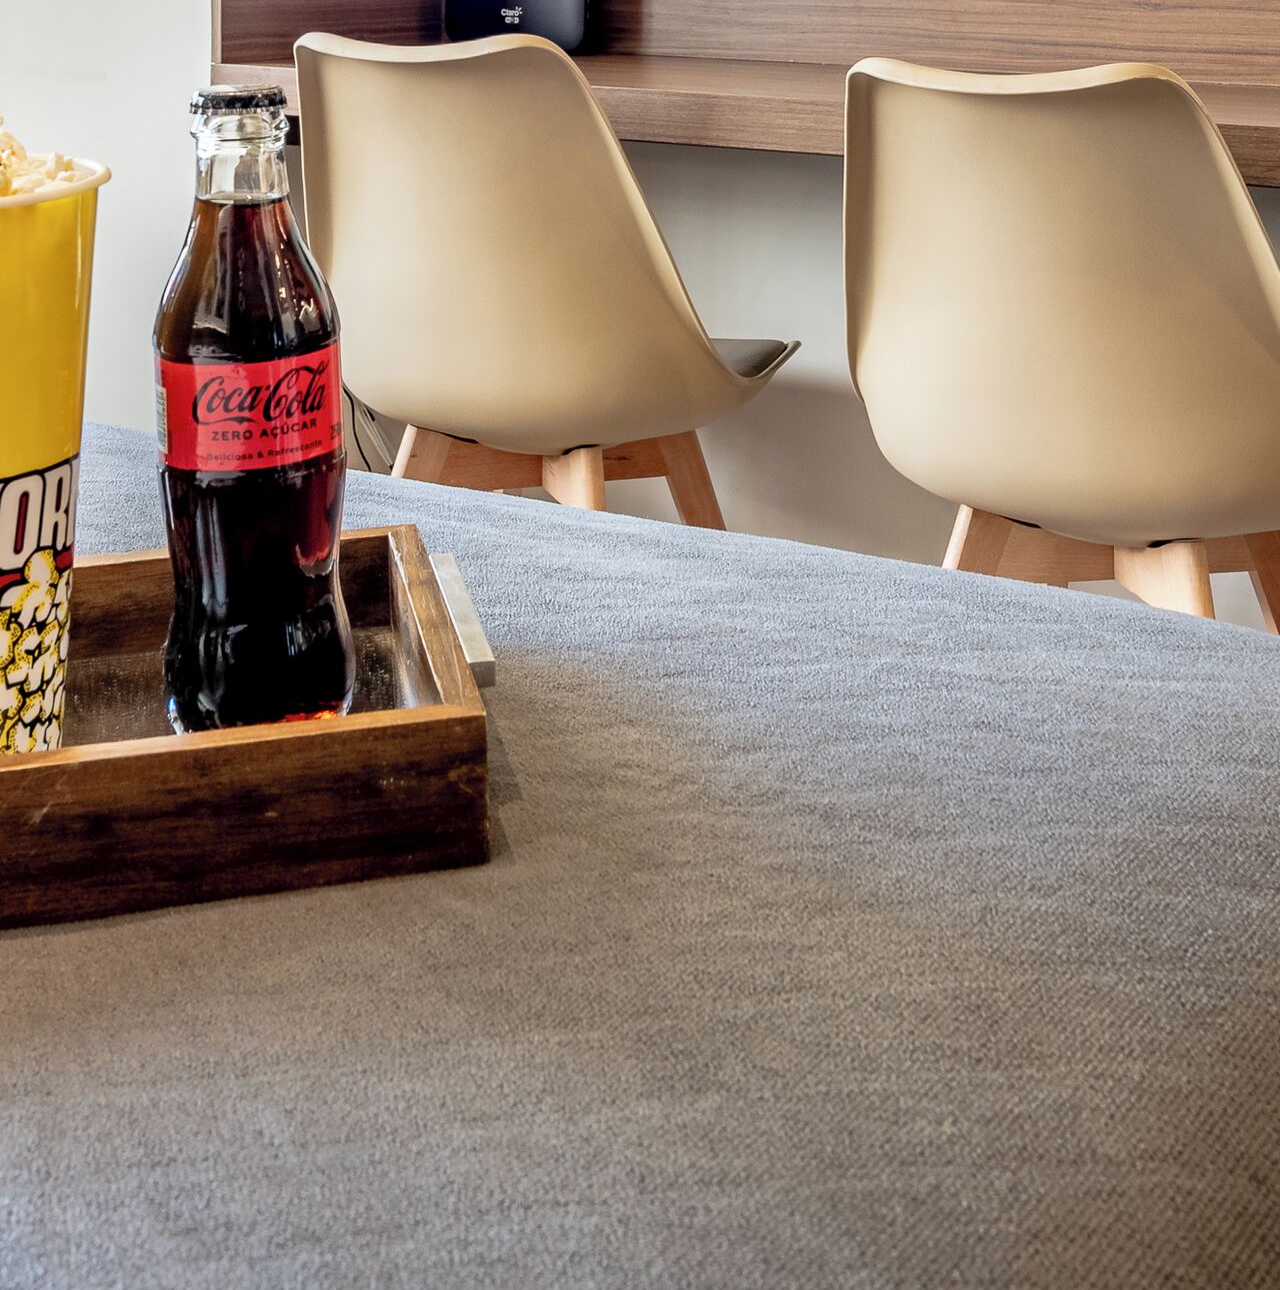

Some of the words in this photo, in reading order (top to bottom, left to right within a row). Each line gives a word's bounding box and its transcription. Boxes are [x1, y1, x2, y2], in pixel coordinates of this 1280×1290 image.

[501, 7, 521, 16] Claro
[192, 360, 329, 425] Coca-Cola
[211, 430, 253, 441] ZERO
[260, 417, 317, 440] AÇÚCAR
[207, 453, 253, 461] Deliciosa
